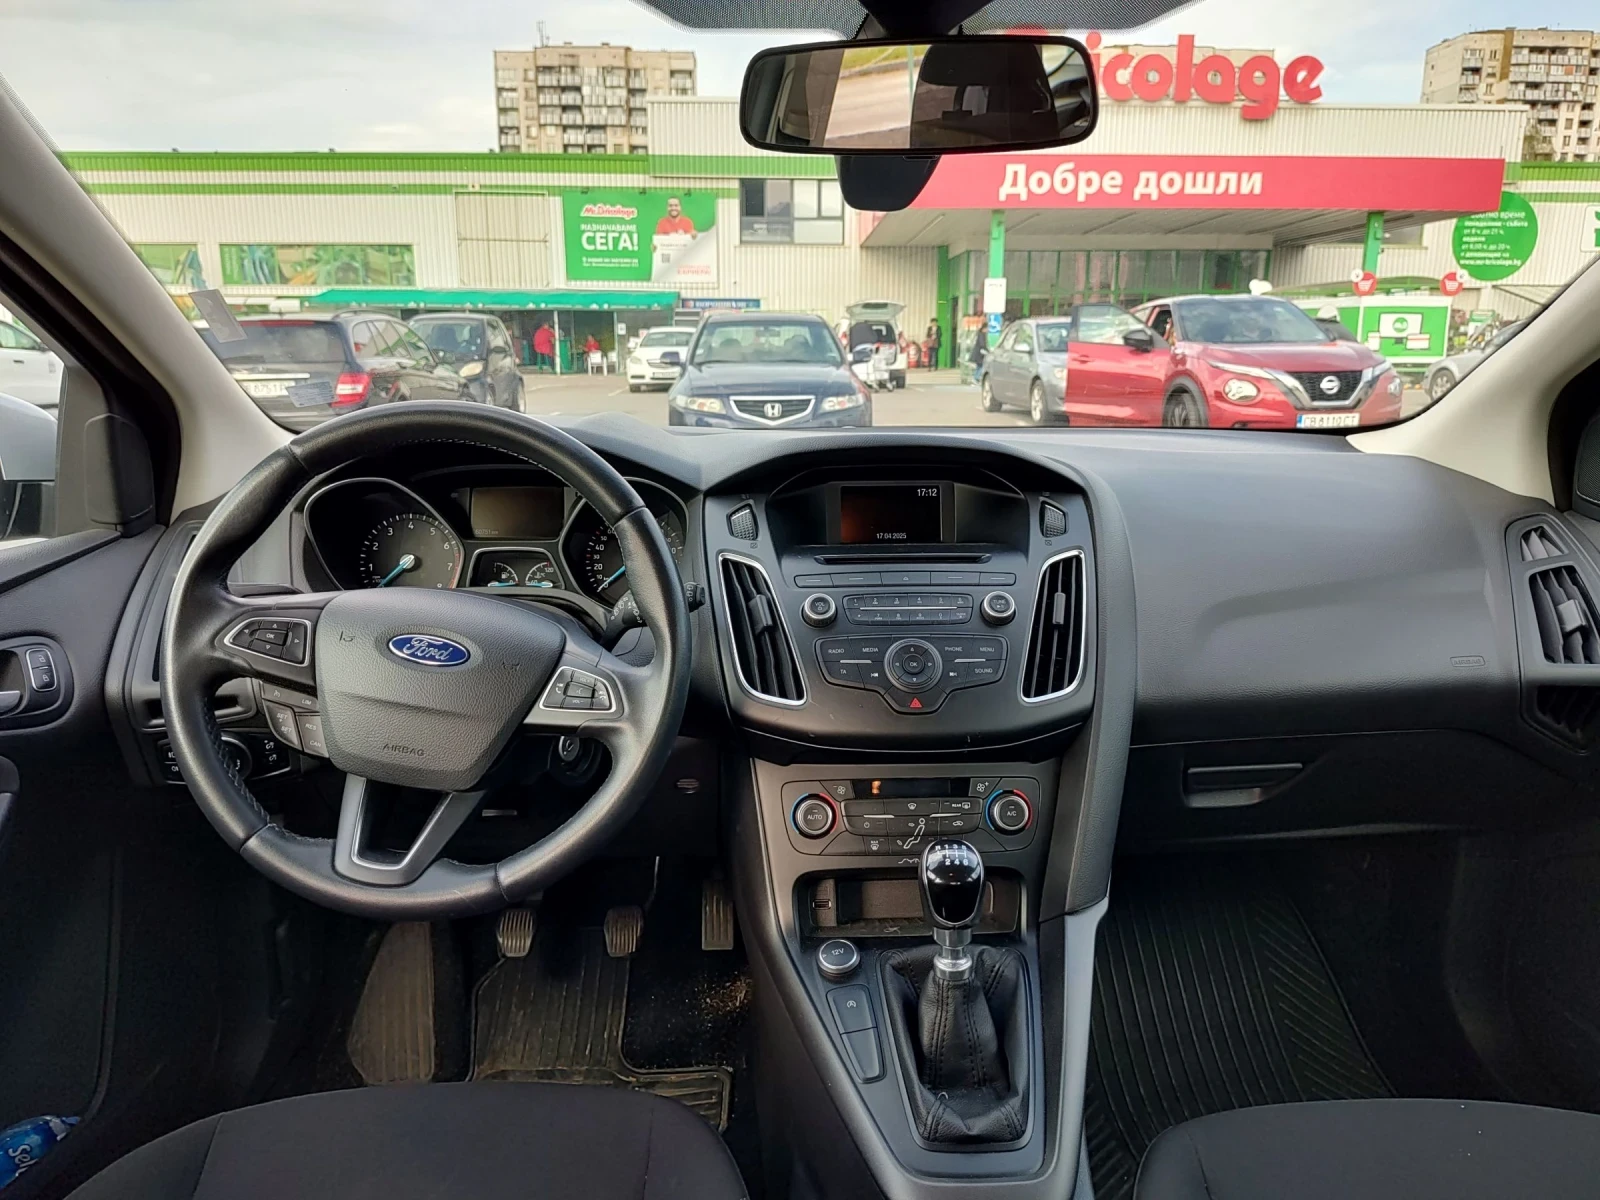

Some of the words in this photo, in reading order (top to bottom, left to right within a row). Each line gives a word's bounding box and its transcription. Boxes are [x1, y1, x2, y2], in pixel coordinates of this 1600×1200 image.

[1004, 24, 1324, 119] icolage
[999, 161, 1123, 201] Добре
[1133, 171, 1263, 200] дошли
[581, 231, 639, 251] СЕГА!
[917, 488, 937, 497] 17:12
[388, 528, 394, 536] 3
[430, 528, 436, 536] 5
[403, 637, 453, 660] Ford
[382, 744, 426, 757] AIRBAG
[831, 948, 844, 956] 12V
